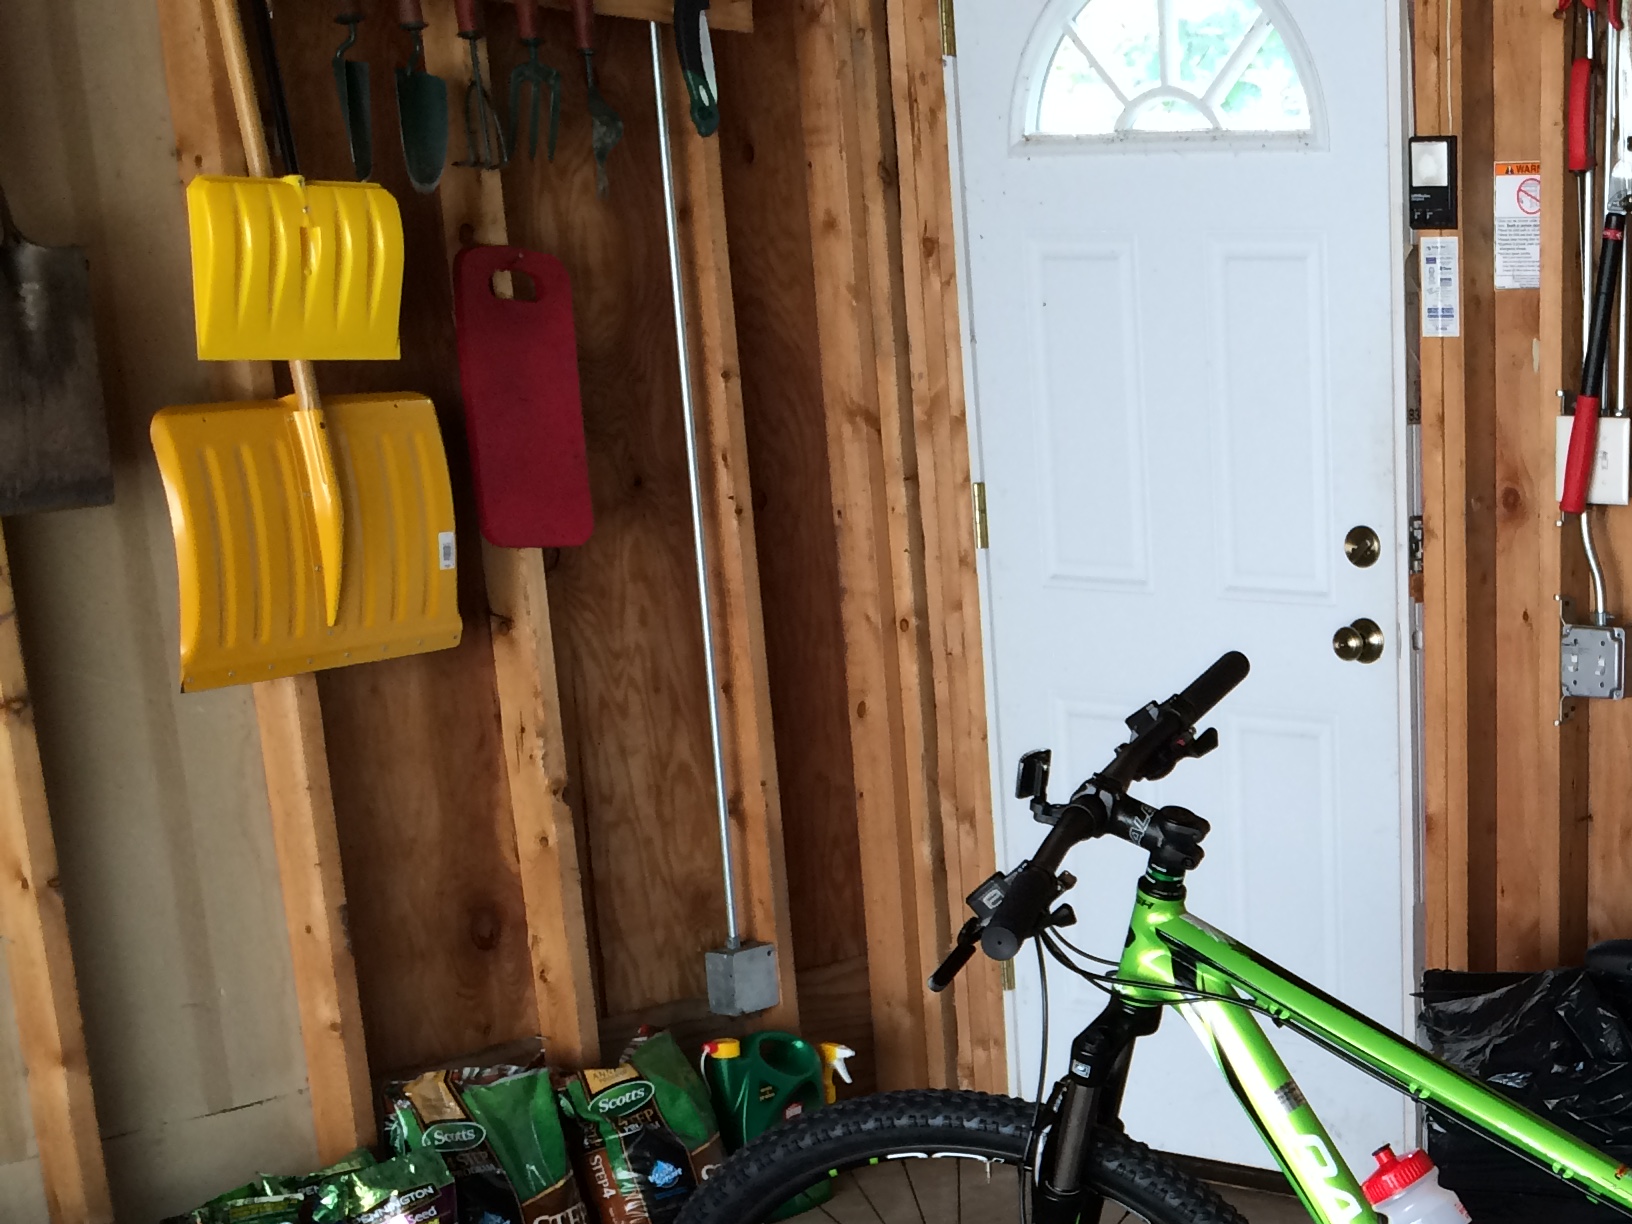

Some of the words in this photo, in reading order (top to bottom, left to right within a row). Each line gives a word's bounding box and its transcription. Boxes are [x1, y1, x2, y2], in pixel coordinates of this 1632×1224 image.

[598, 1087, 646, 1113] Scotts
[433, 1128, 477, 1146] Scotts
[589, 1153, 610, 1188] STEP
